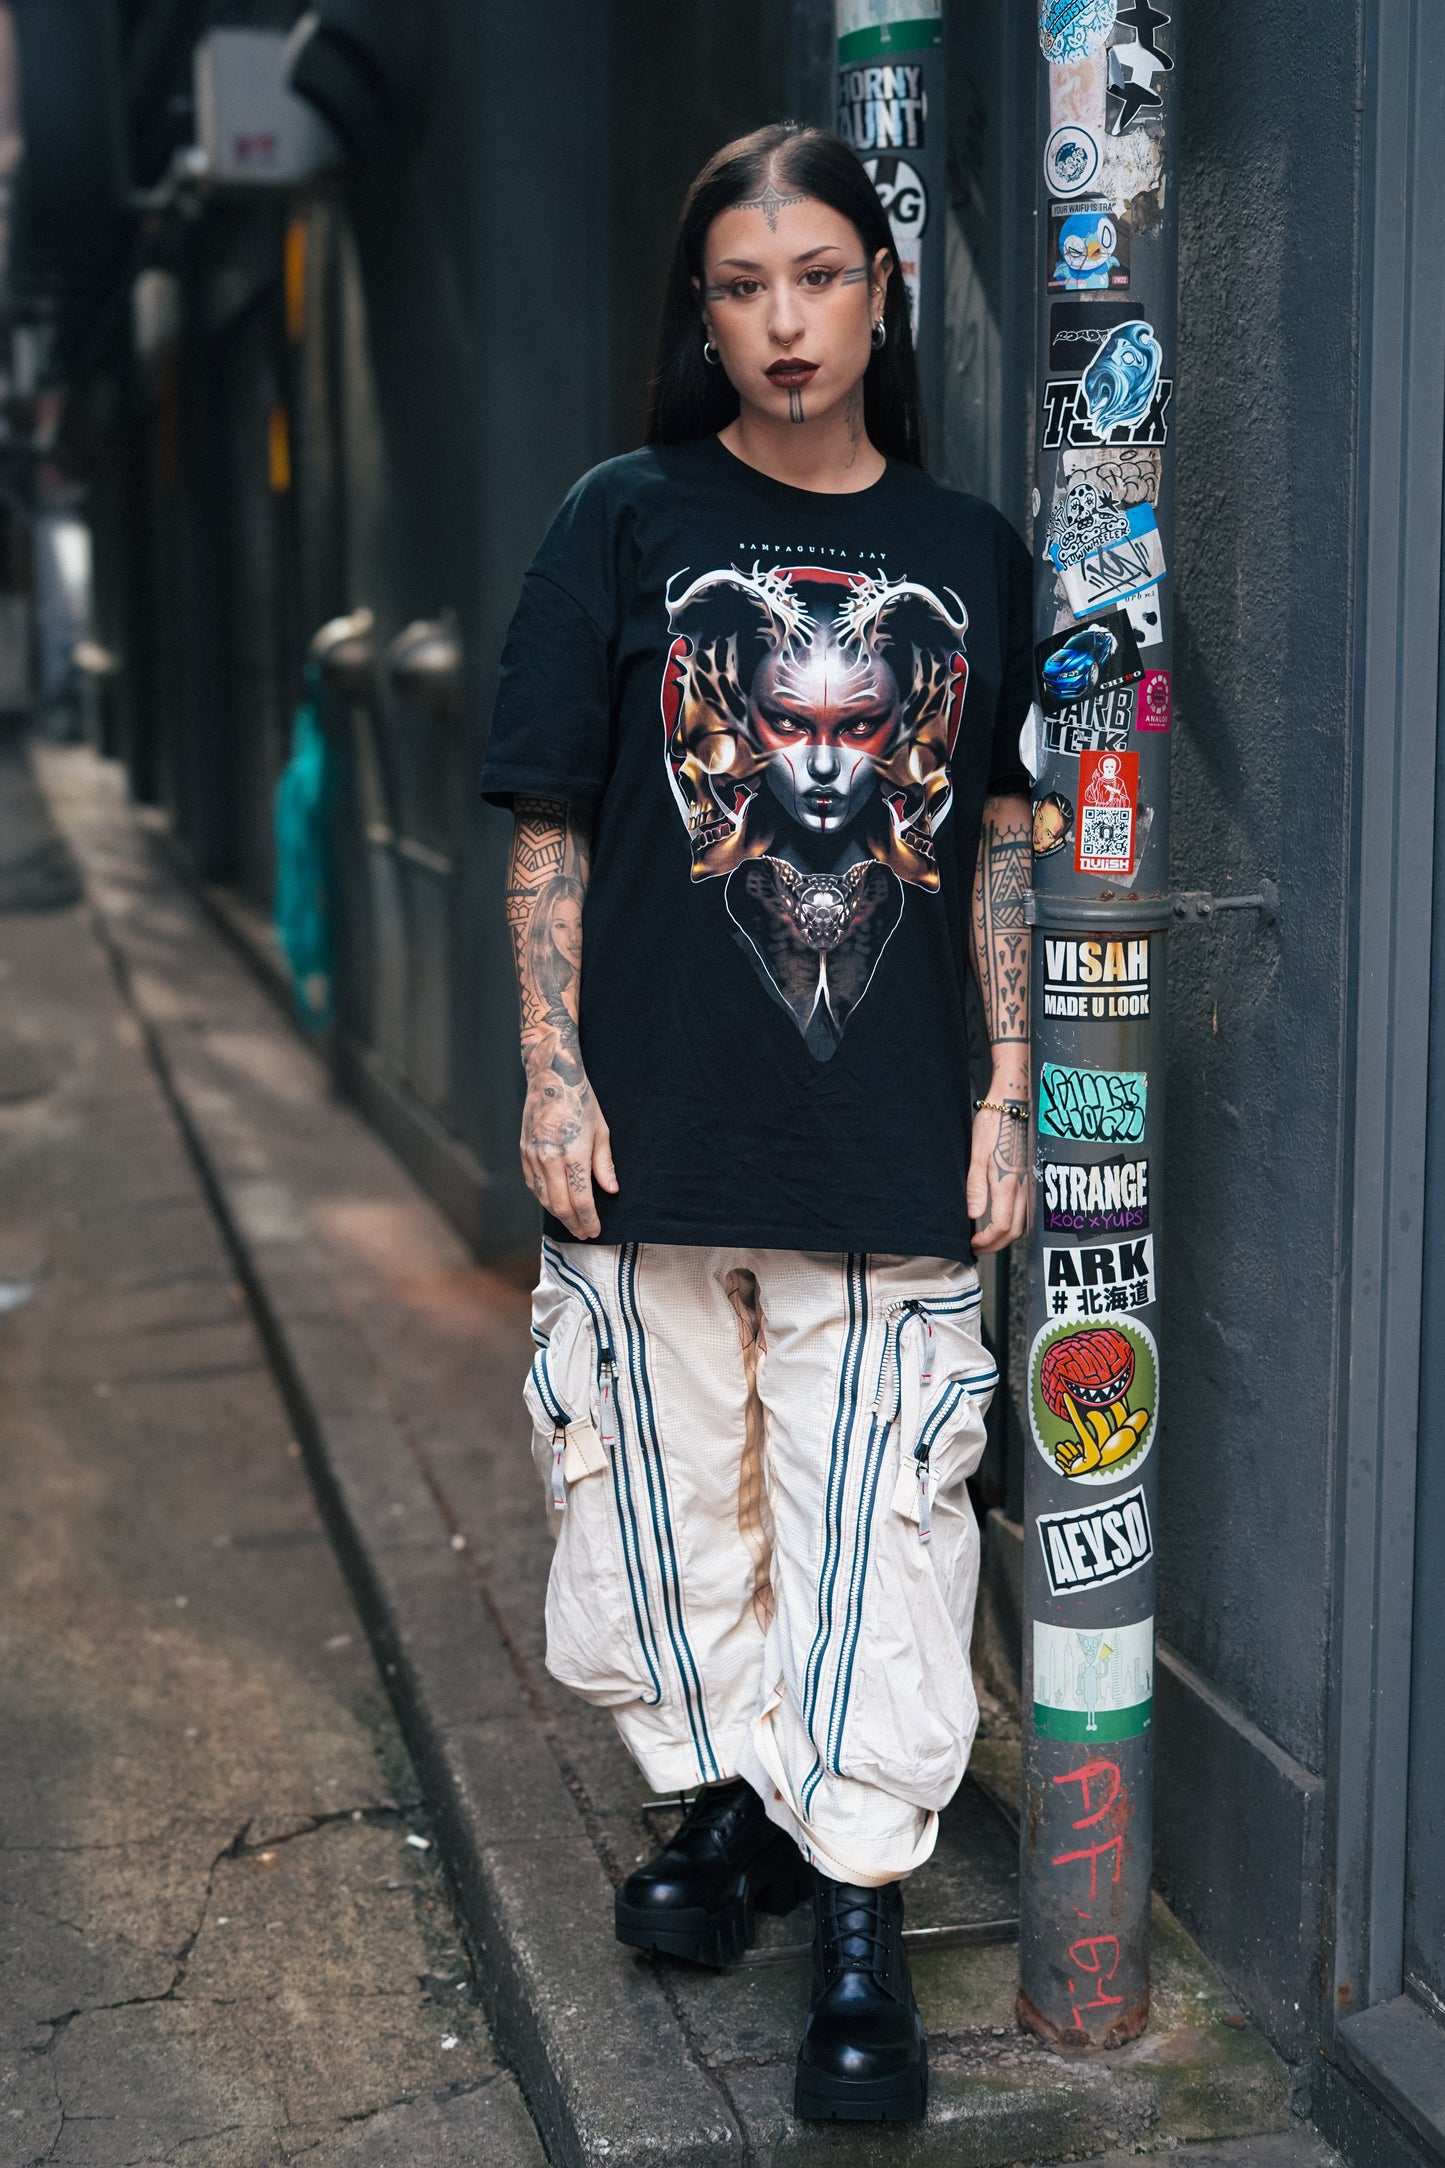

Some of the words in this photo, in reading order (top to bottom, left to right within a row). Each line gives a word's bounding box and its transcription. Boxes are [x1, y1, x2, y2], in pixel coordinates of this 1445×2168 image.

[1053, 205, 1068, 215] YOUR
[1069, 203, 1090, 213] WAIFU
[1090, 202, 1098, 212] IS
[739, 543, 847, 558] SAMPAGUITA
[858, 552, 887, 560] JAY
[1045, 939, 1149, 983] VISAH
[1045, 994, 1088, 1017] MADE
[1092, 996, 1104, 1018] U
[1108, 993, 1150, 1018] LOOK
[1044, 1161, 1147, 1214] STRANGE
[1050, 1211, 1085, 1229] KOC
[1048, 1239, 1150, 1287] ARK
